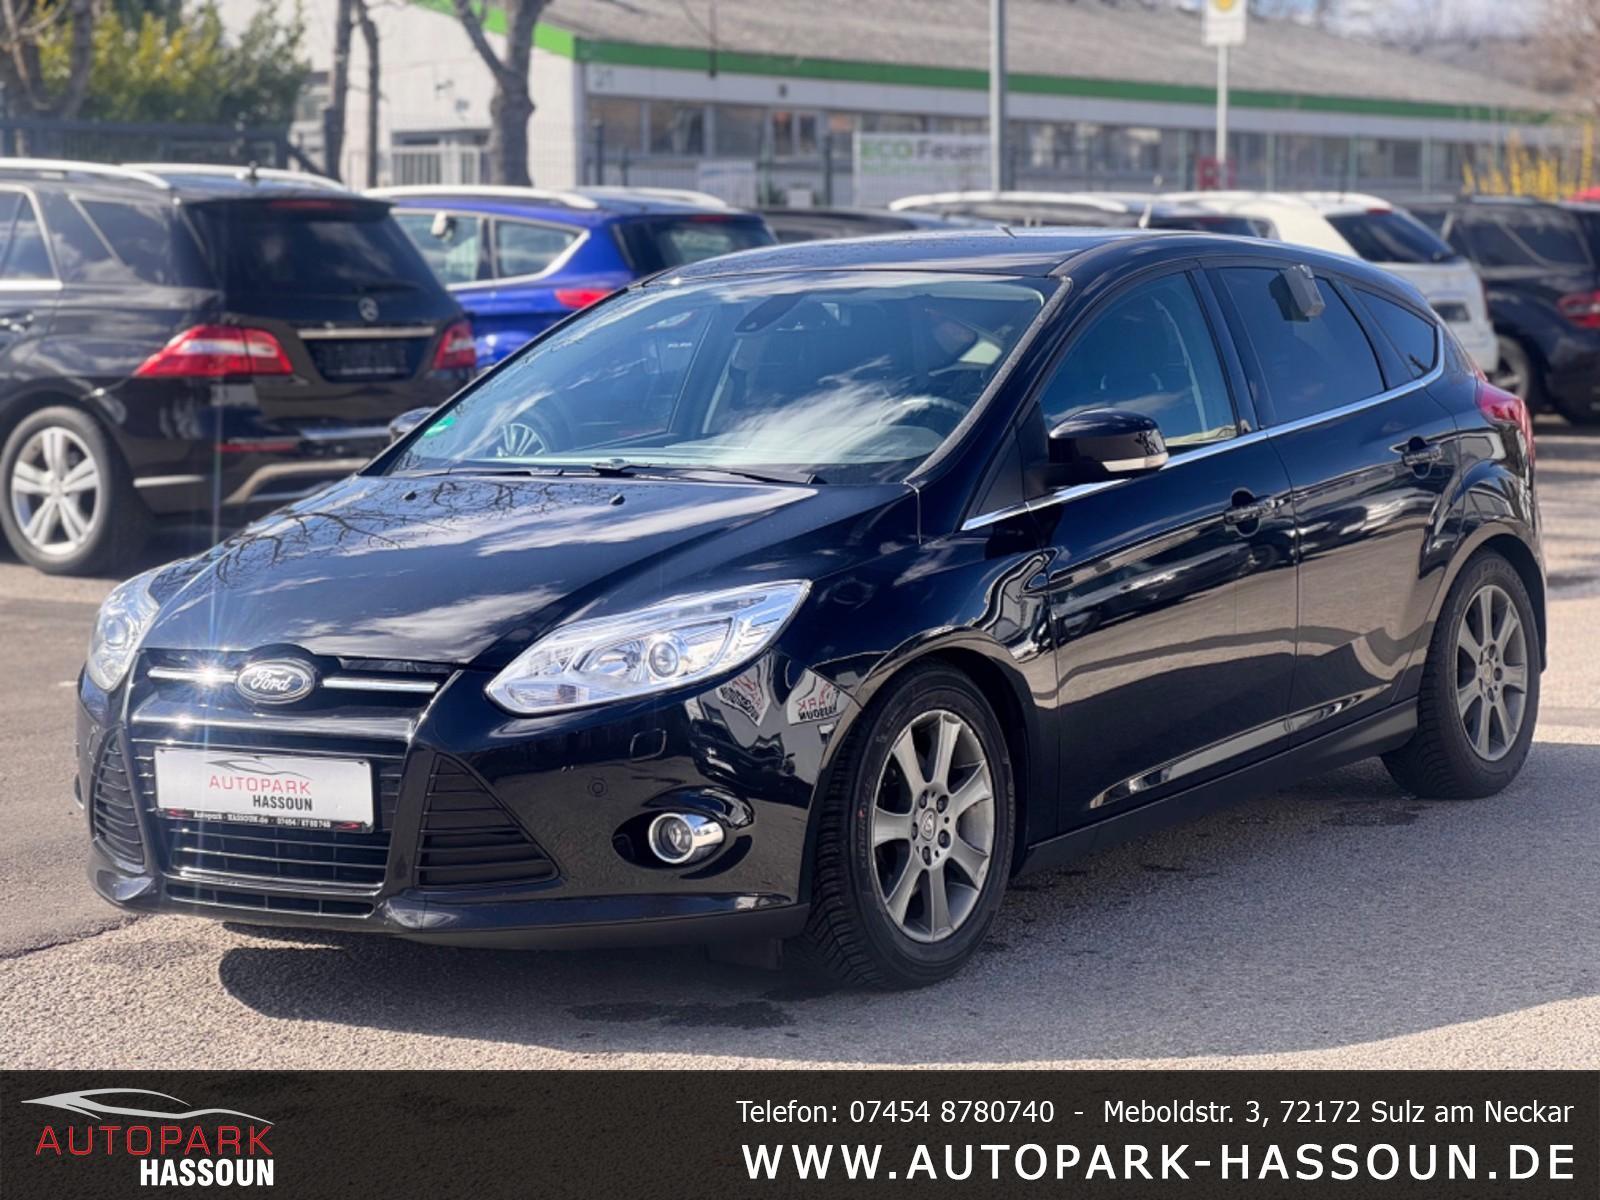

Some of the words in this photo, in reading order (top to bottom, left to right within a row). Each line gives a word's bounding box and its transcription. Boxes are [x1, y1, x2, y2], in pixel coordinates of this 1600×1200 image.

[862, 140, 912, 158] ECO
[250, 669, 294, 691] Ford
[208, 775, 312, 795] AUTOPARK
[252, 795, 313, 811] HASSOUN
